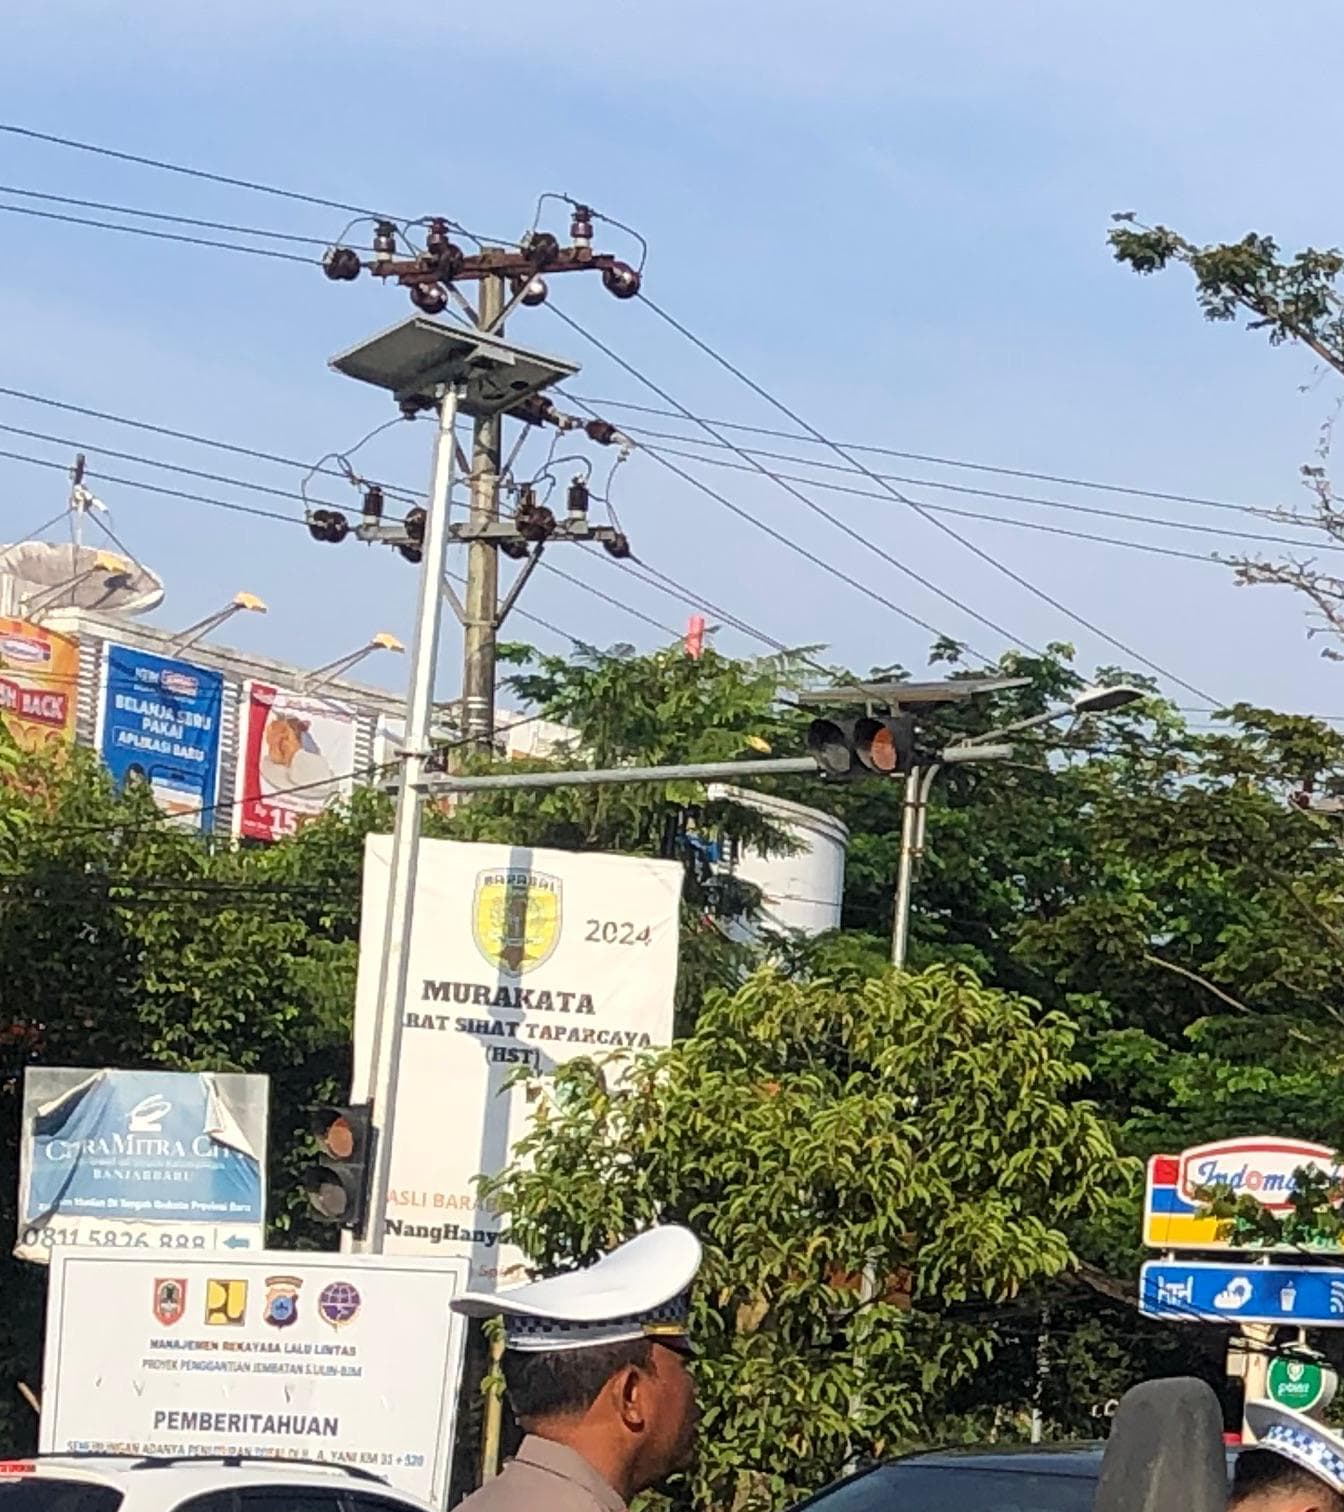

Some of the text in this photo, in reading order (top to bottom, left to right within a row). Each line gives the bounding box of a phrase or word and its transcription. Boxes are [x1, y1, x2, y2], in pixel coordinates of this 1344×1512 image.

[22, 694, 64, 719] BACK
[585, 918, 652, 946] 2024
[422, 980, 597, 1015] MURAKATA
[401, 1012, 450, 1031] RAT
[455, 1017, 520, 1038] SIHAT
[387, 1190, 427, 1207] ASLI
[153, 1411, 339, 1436] PEMBERITAHUAN
